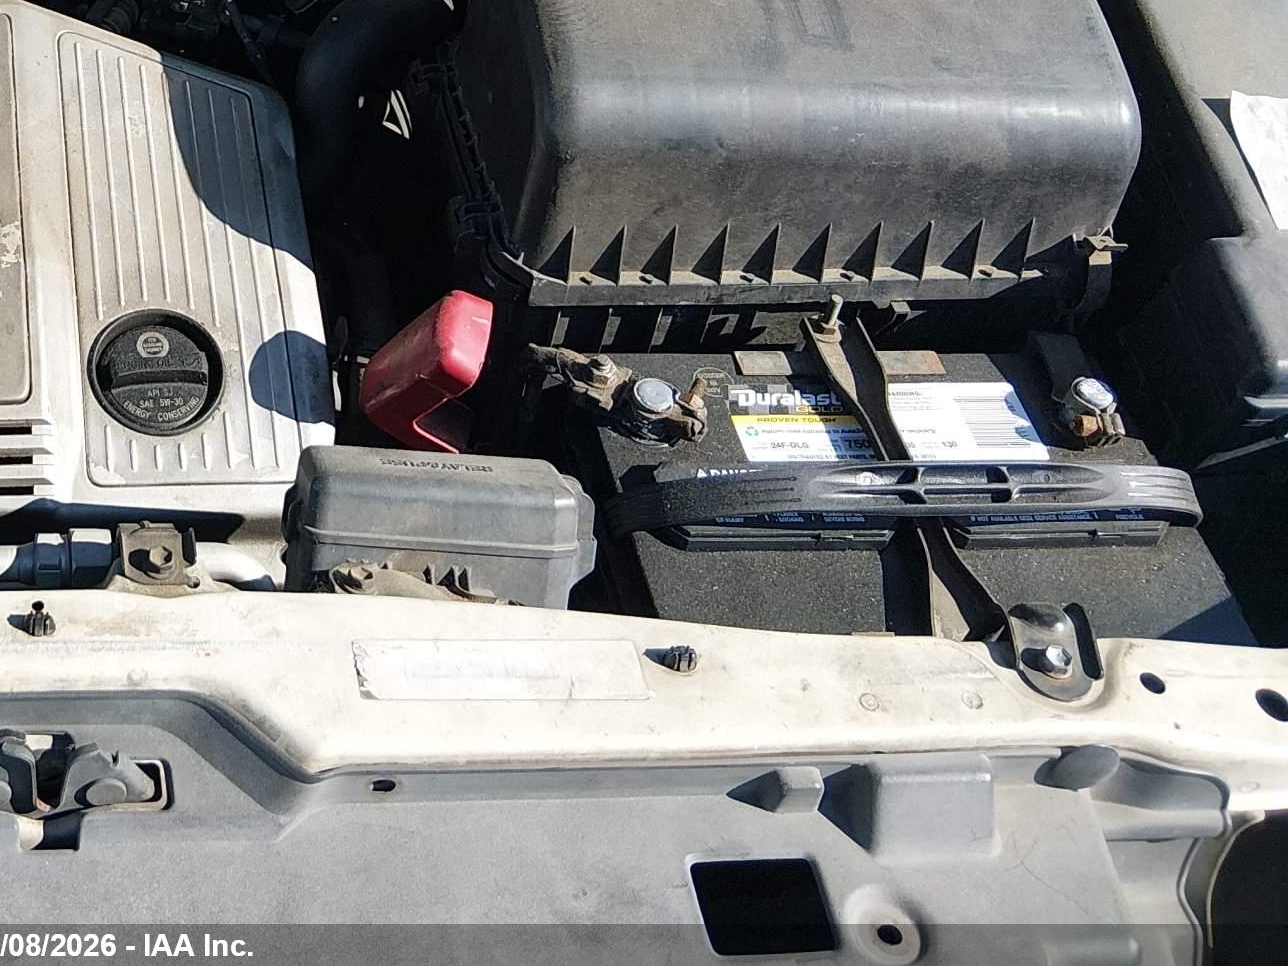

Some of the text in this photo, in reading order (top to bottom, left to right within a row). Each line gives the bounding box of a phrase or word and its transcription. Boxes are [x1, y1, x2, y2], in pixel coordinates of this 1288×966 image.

[139, 397, 184, 408] SAE 5W-30
[730, 388, 842, 407] Duralast
[123, 396, 200, 422] ENERGY CONSERVING
[795, 405, 843, 414] GOLD
